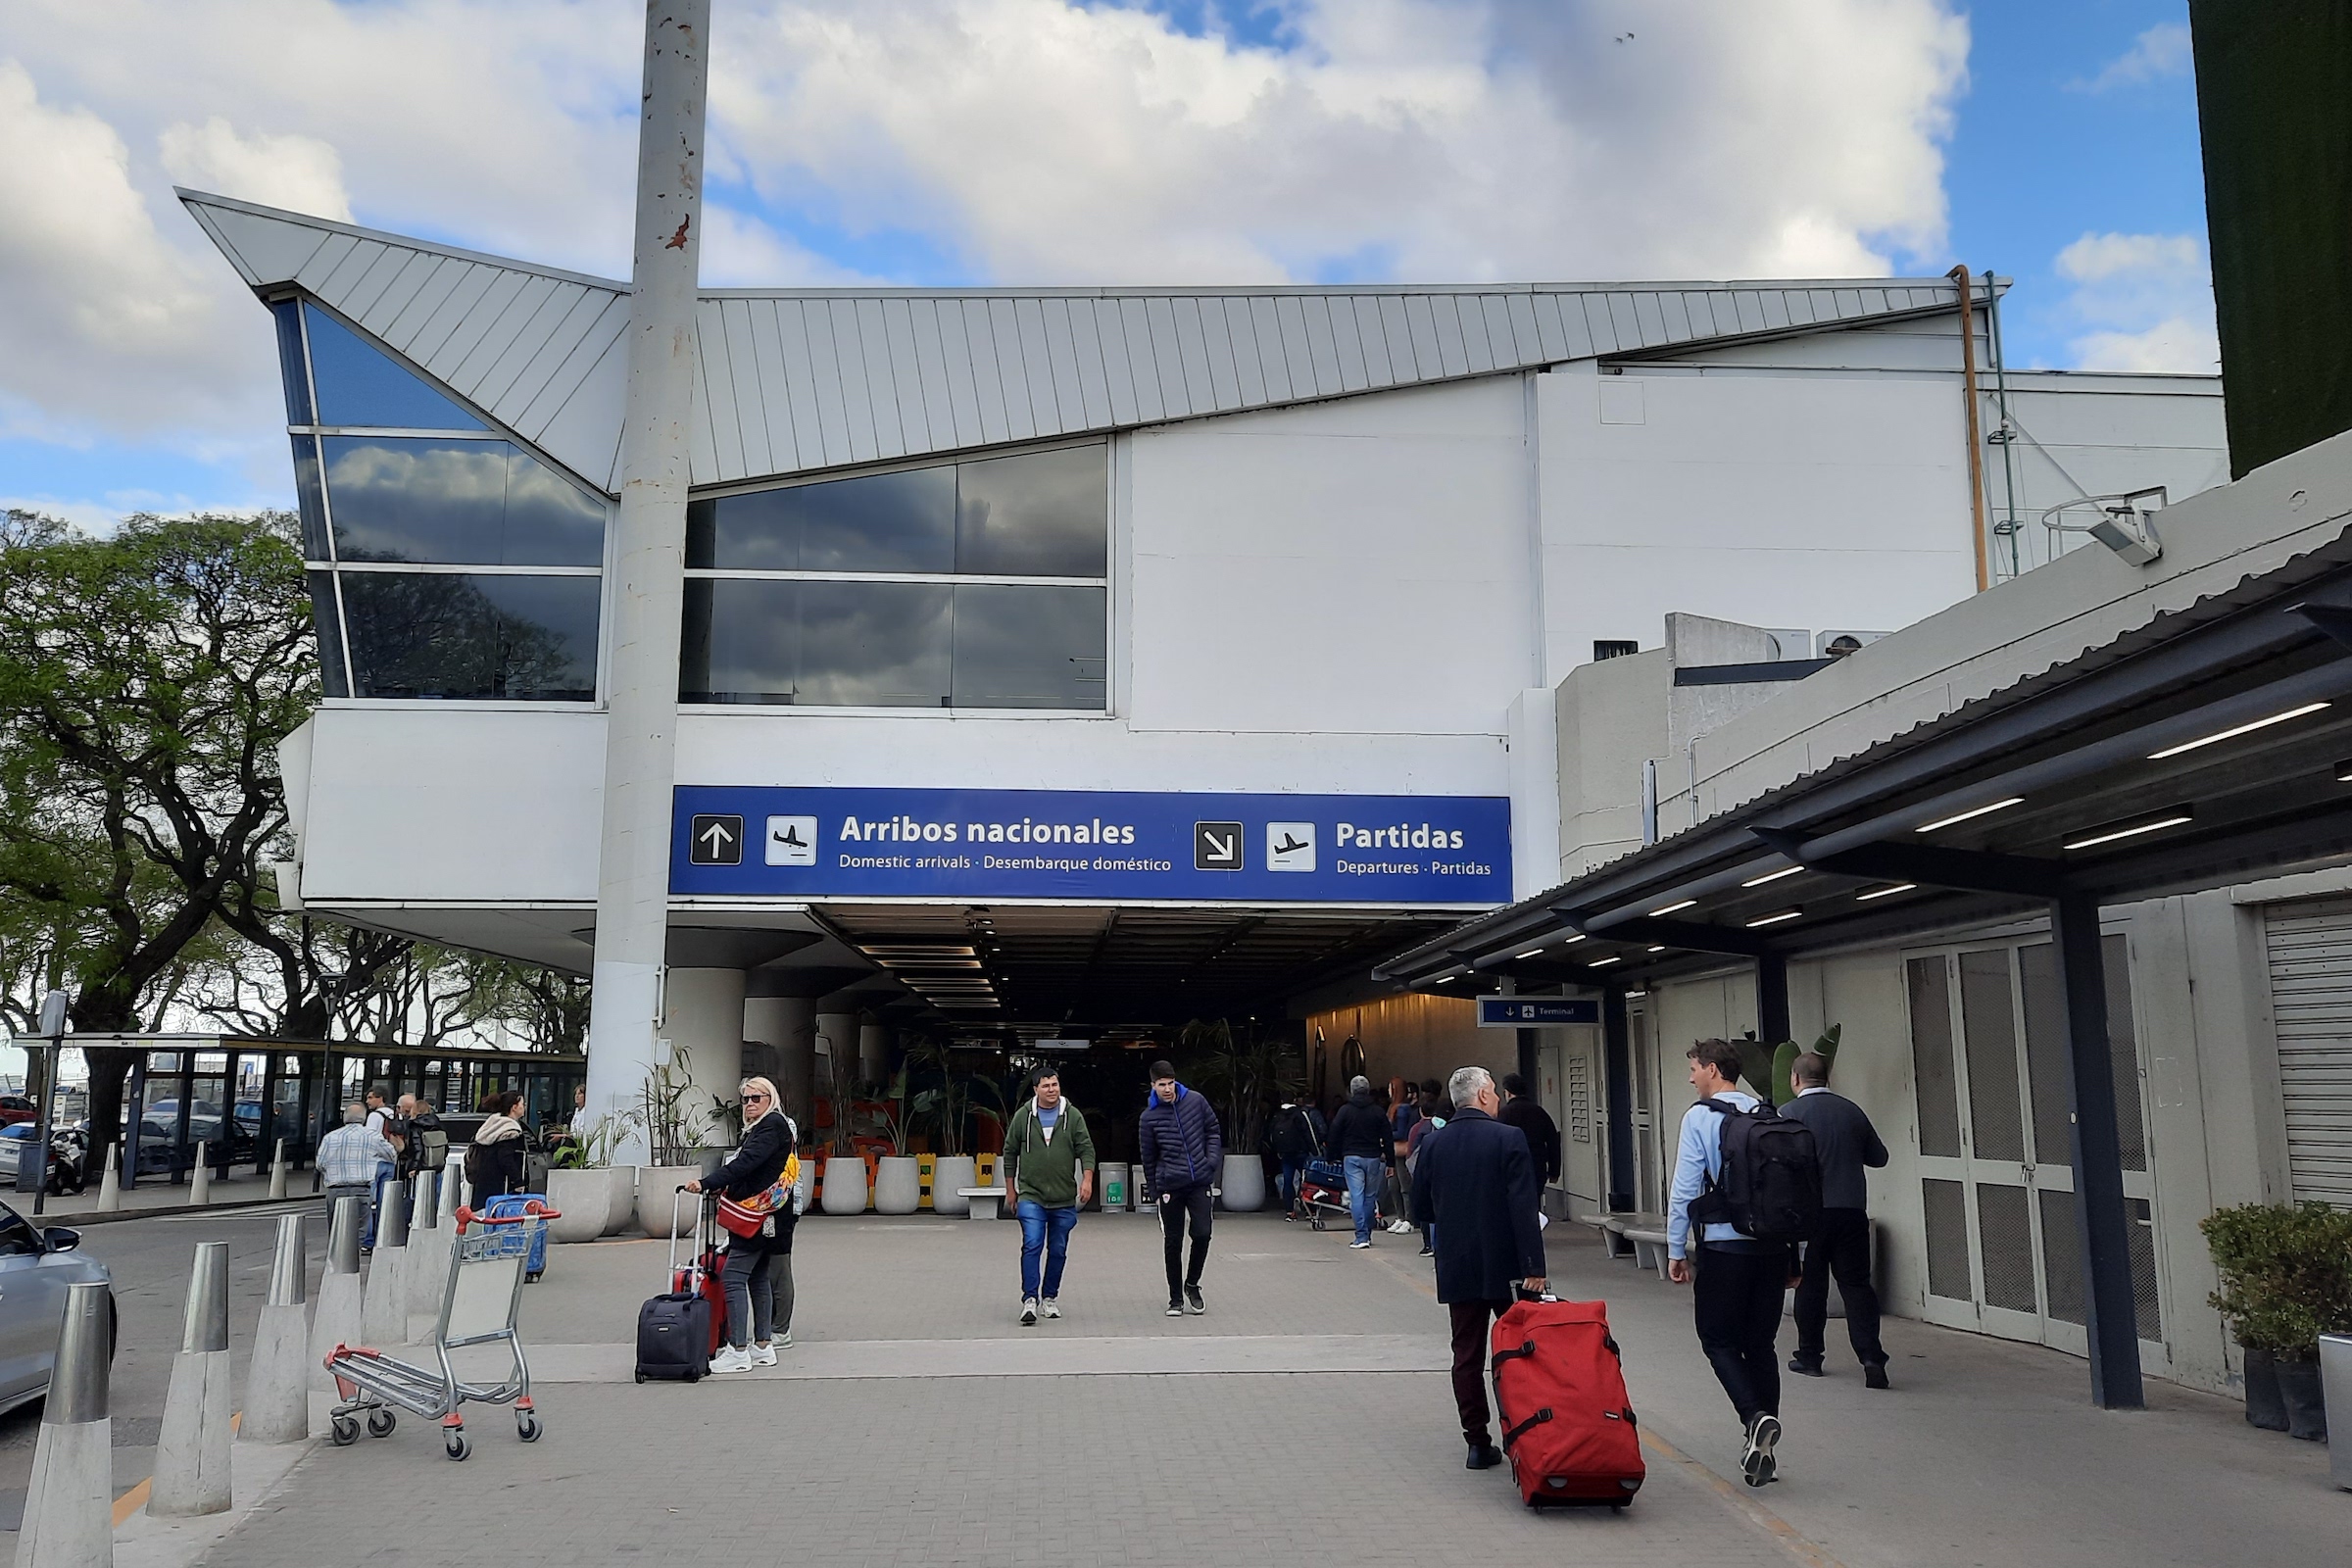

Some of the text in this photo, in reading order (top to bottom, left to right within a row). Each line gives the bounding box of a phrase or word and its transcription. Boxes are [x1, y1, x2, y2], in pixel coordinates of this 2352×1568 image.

[839, 814, 1136, 846] Arribos nacionales
[1336, 822, 1465, 850] Partidas
[839, 854, 1171, 873] Domestic arrivals Desembarque doméstico
[1337, 859, 1492, 877] Departures Partidas
[1539, 1007, 1574, 1016] Terminal
